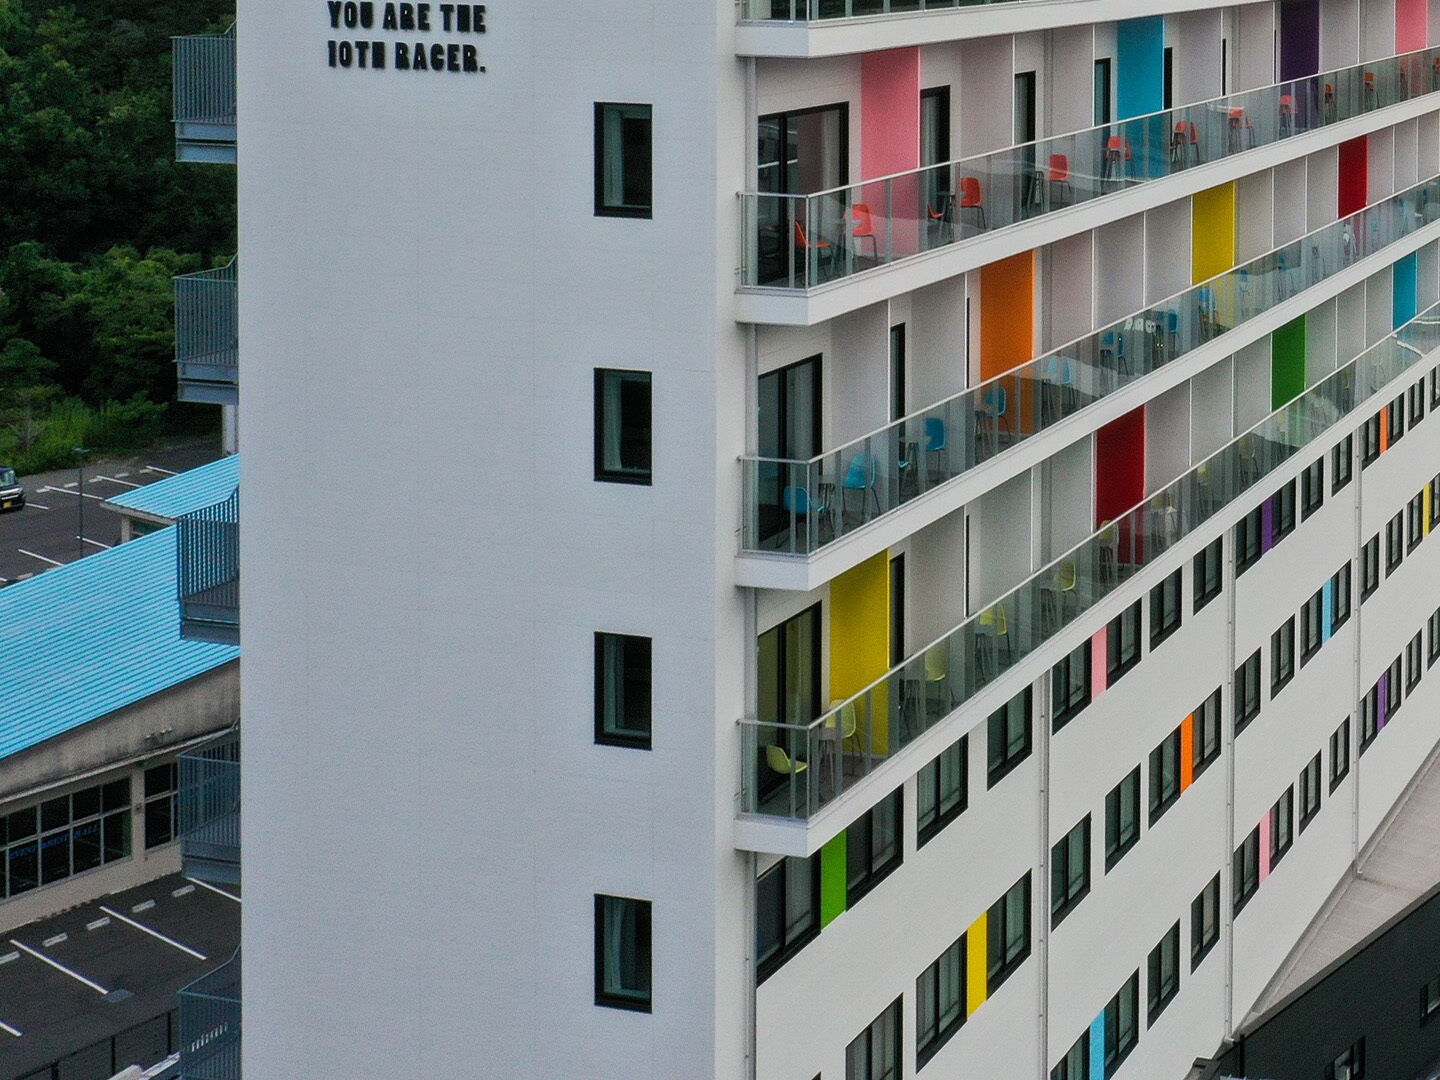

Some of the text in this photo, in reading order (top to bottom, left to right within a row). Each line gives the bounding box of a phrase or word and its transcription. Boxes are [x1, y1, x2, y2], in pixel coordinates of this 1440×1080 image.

[328, 1, 487, 33] YOU ARE THE
[328, 40, 487, 73] 10TH RACER.
